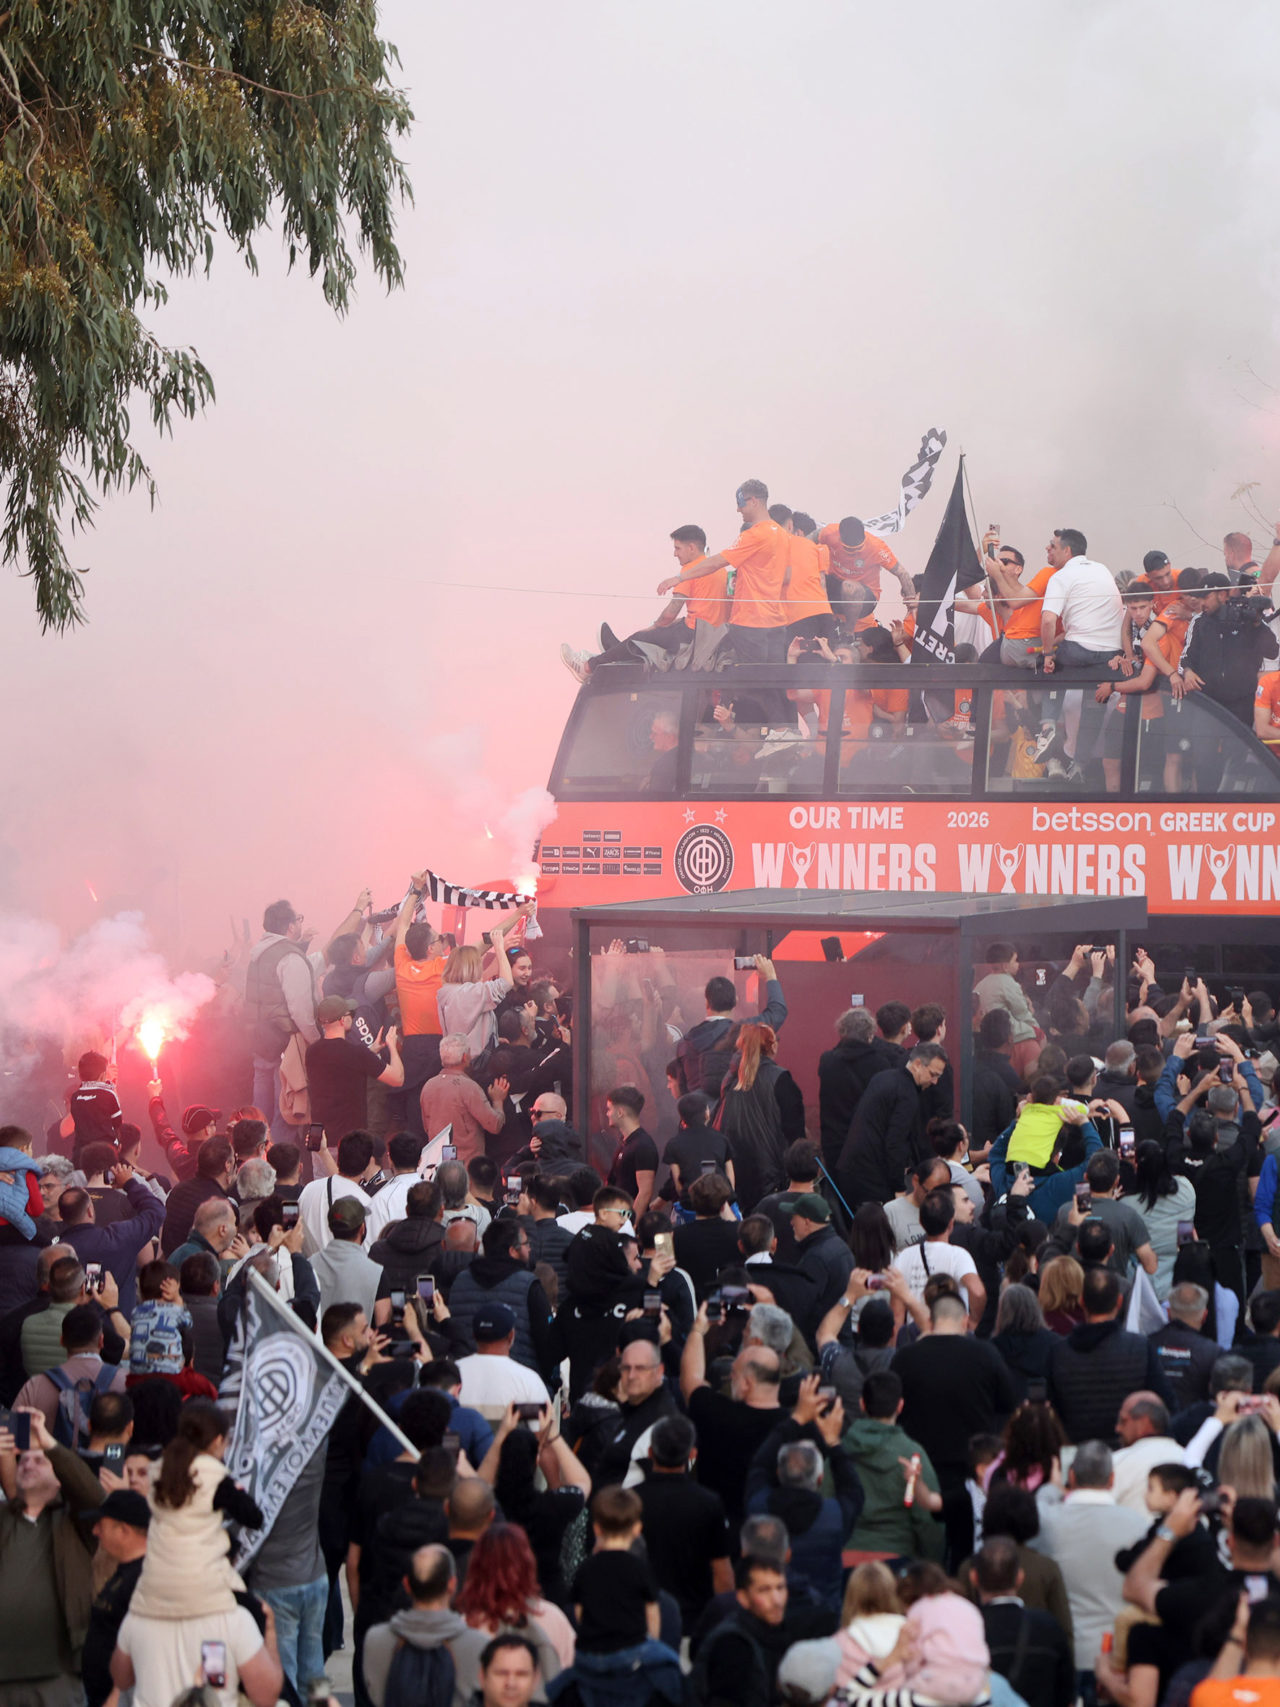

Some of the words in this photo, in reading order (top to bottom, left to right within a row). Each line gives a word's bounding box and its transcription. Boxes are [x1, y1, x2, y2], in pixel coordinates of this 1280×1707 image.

[913, 626, 956, 664] CRET
[789, 806, 843, 830] OUR
[847, 806, 904, 830] TIME
[946, 810, 990, 829] 2026
[1032, 806, 1152, 832] betsson
[1159, 811, 1230, 833] GREEK
[1231, 811, 1276, 833] CUP
[751, 841, 937, 892] WINNERS
[958, 842, 1146, 896] WINNERS
